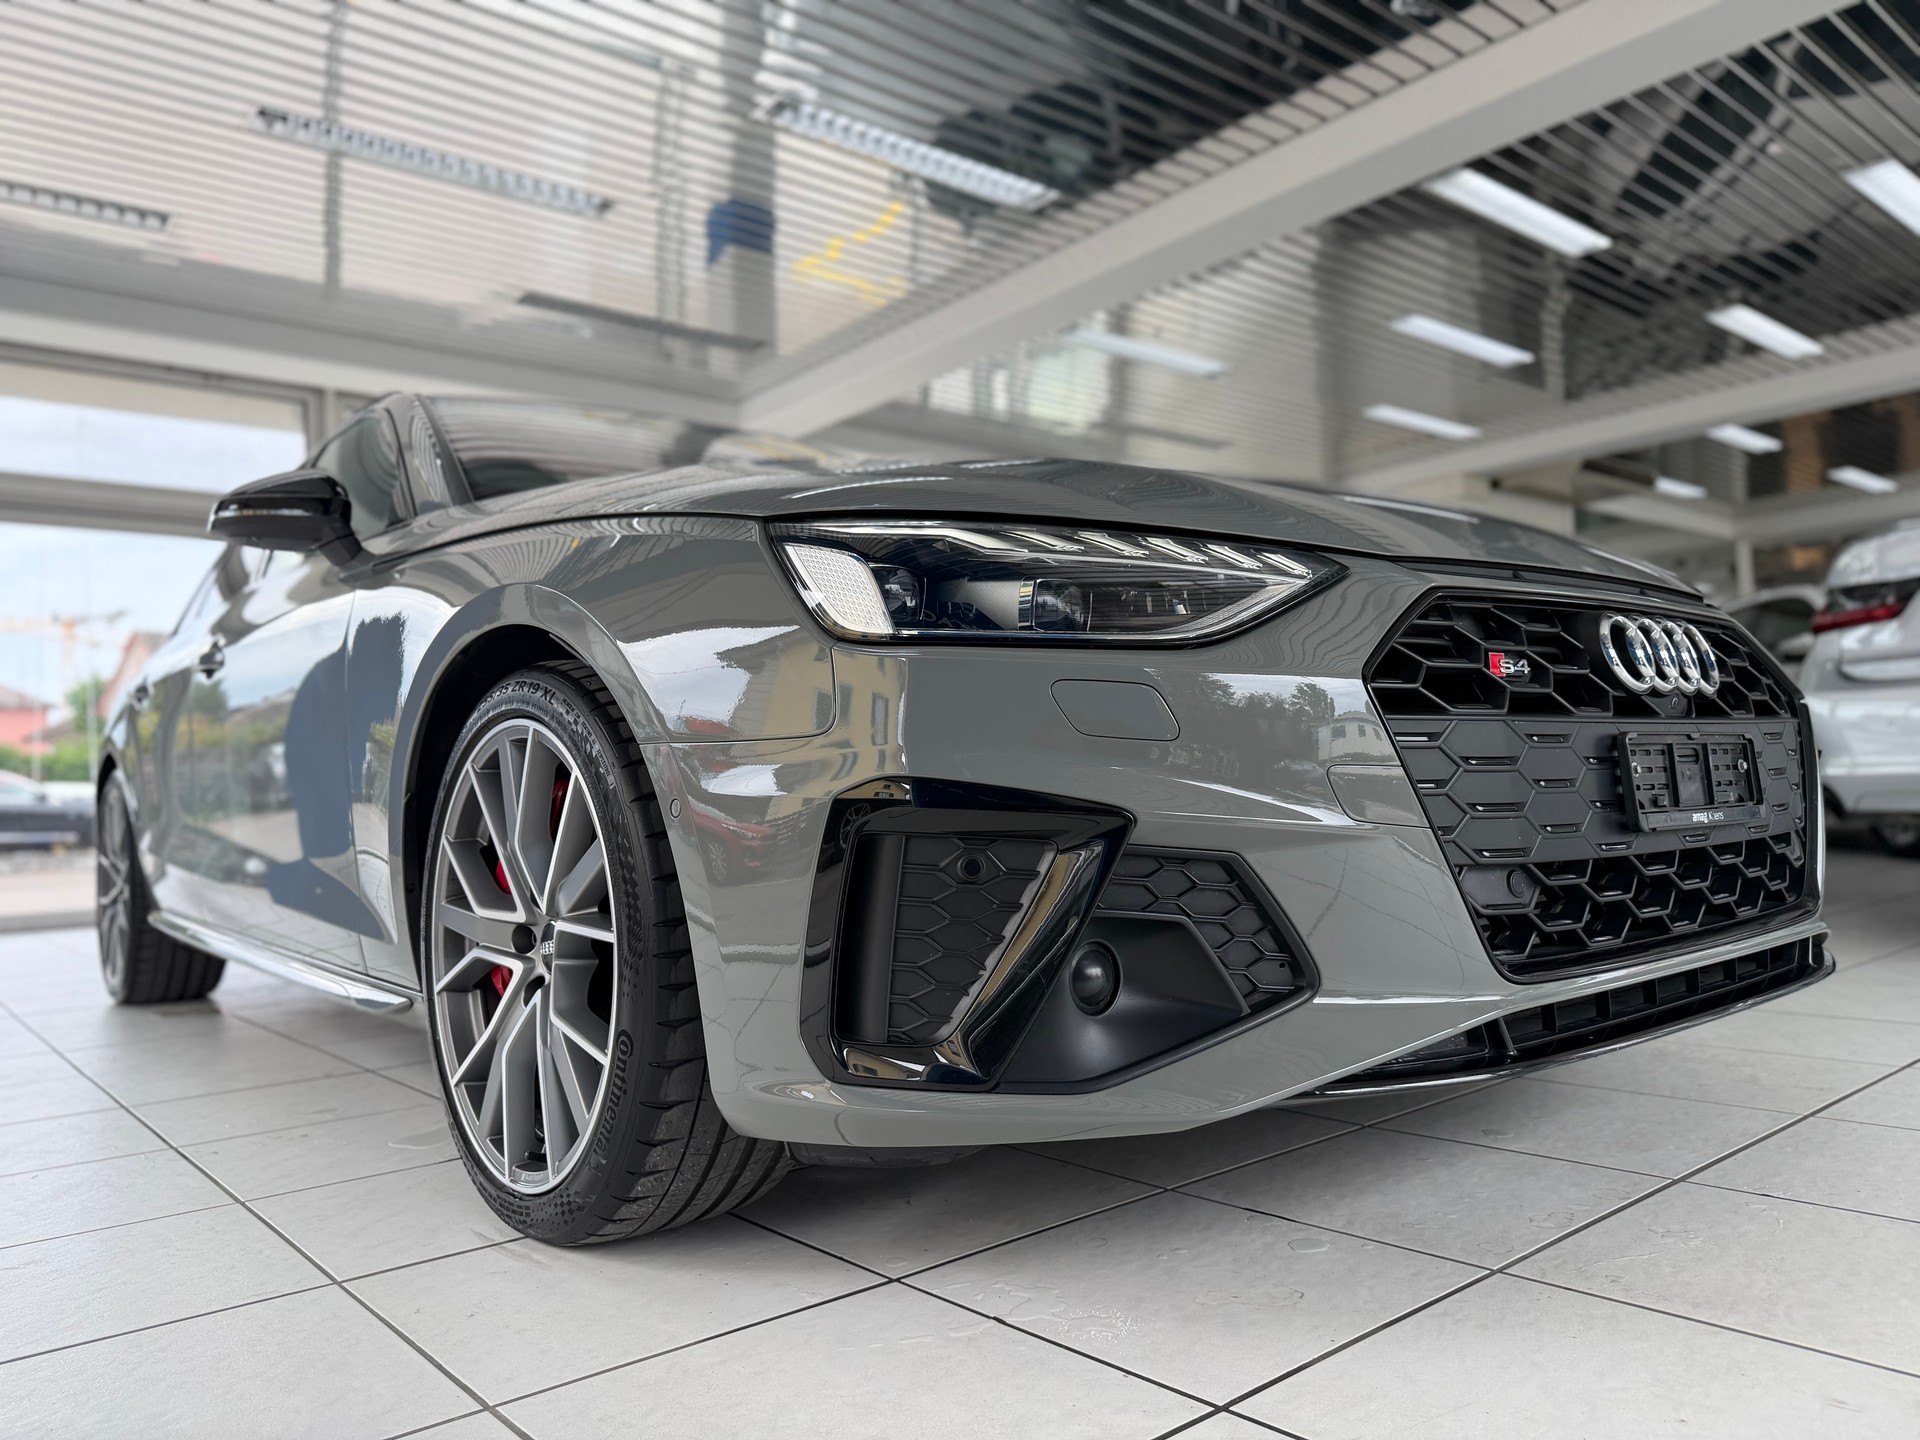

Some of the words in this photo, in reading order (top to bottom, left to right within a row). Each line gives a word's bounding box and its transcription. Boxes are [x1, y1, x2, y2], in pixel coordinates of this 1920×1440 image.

[1500, 658, 1531, 674] S4
[541, 686, 558, 706] XL
[1692, 811, 1708, 823] amag
[593, 1029, 634, 1165] Continental
